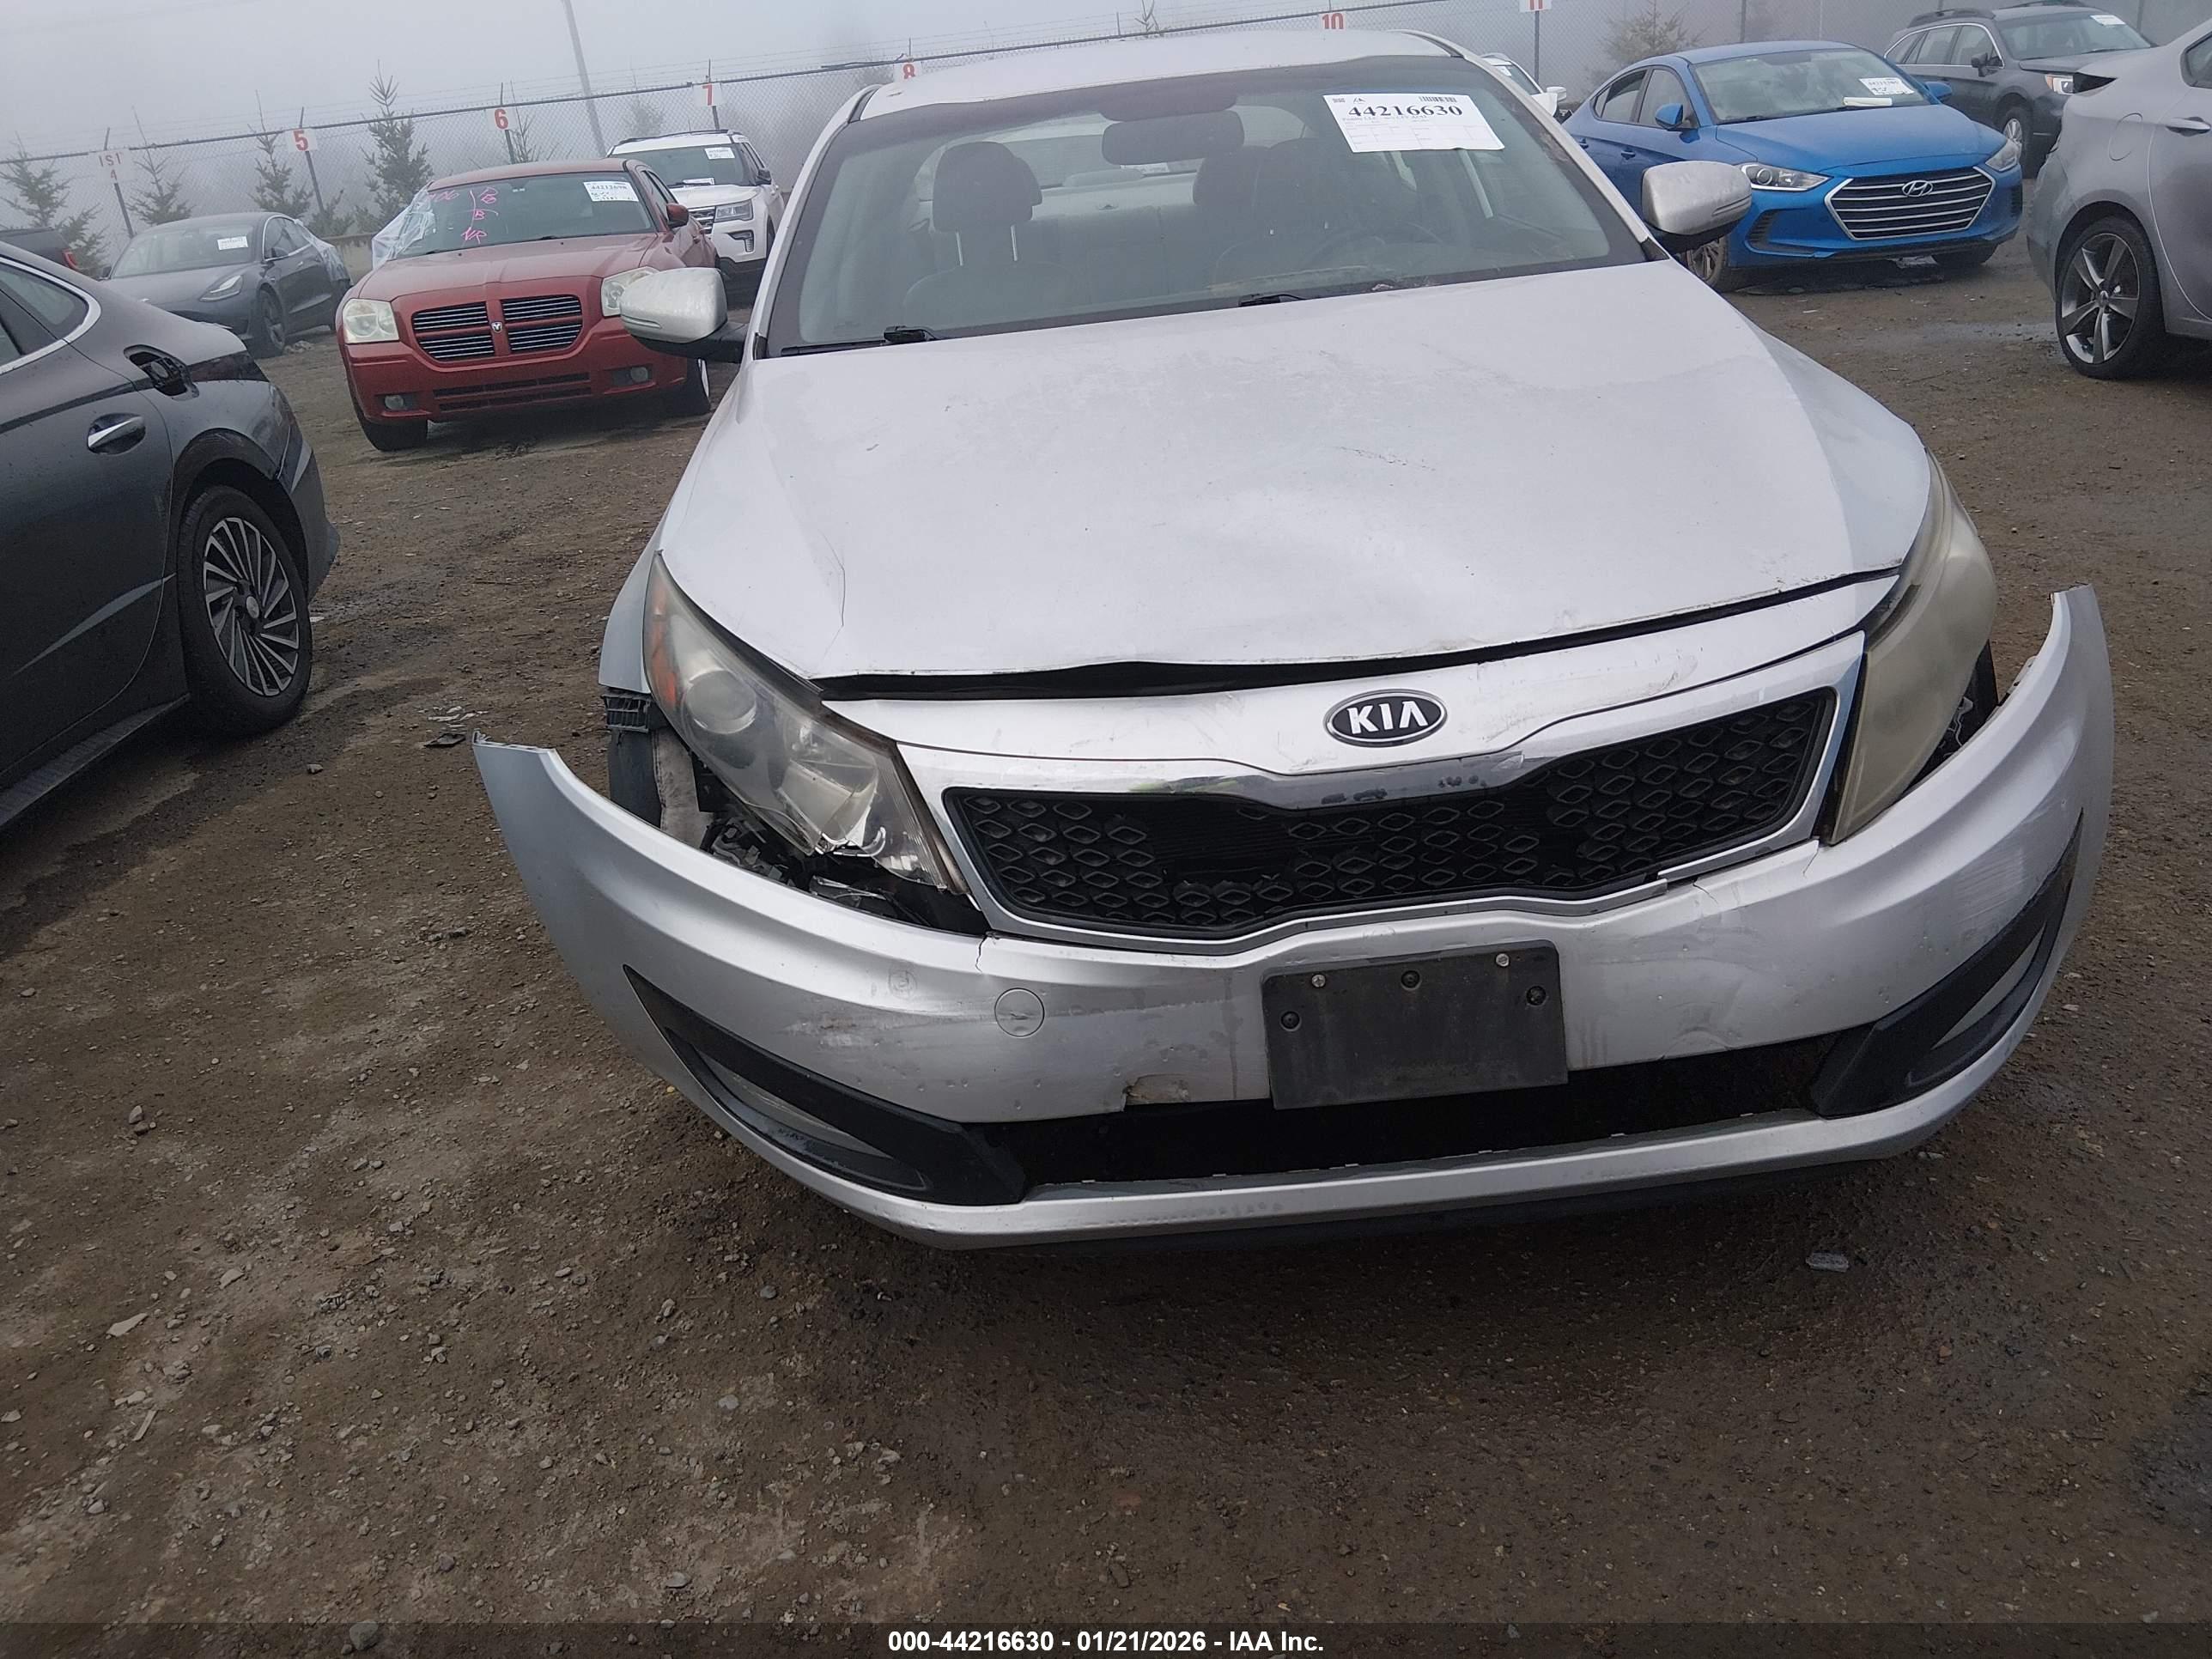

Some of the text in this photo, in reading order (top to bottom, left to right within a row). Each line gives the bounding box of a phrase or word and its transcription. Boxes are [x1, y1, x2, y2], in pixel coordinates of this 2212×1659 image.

[702, 83, 713, 106] 7
[494, 108, 509, 130] 6
[1348, 105, 1463, 117] 44216630
[293, 130, 309, 151] 5
[1346, 700, 1429, 735] KIA
